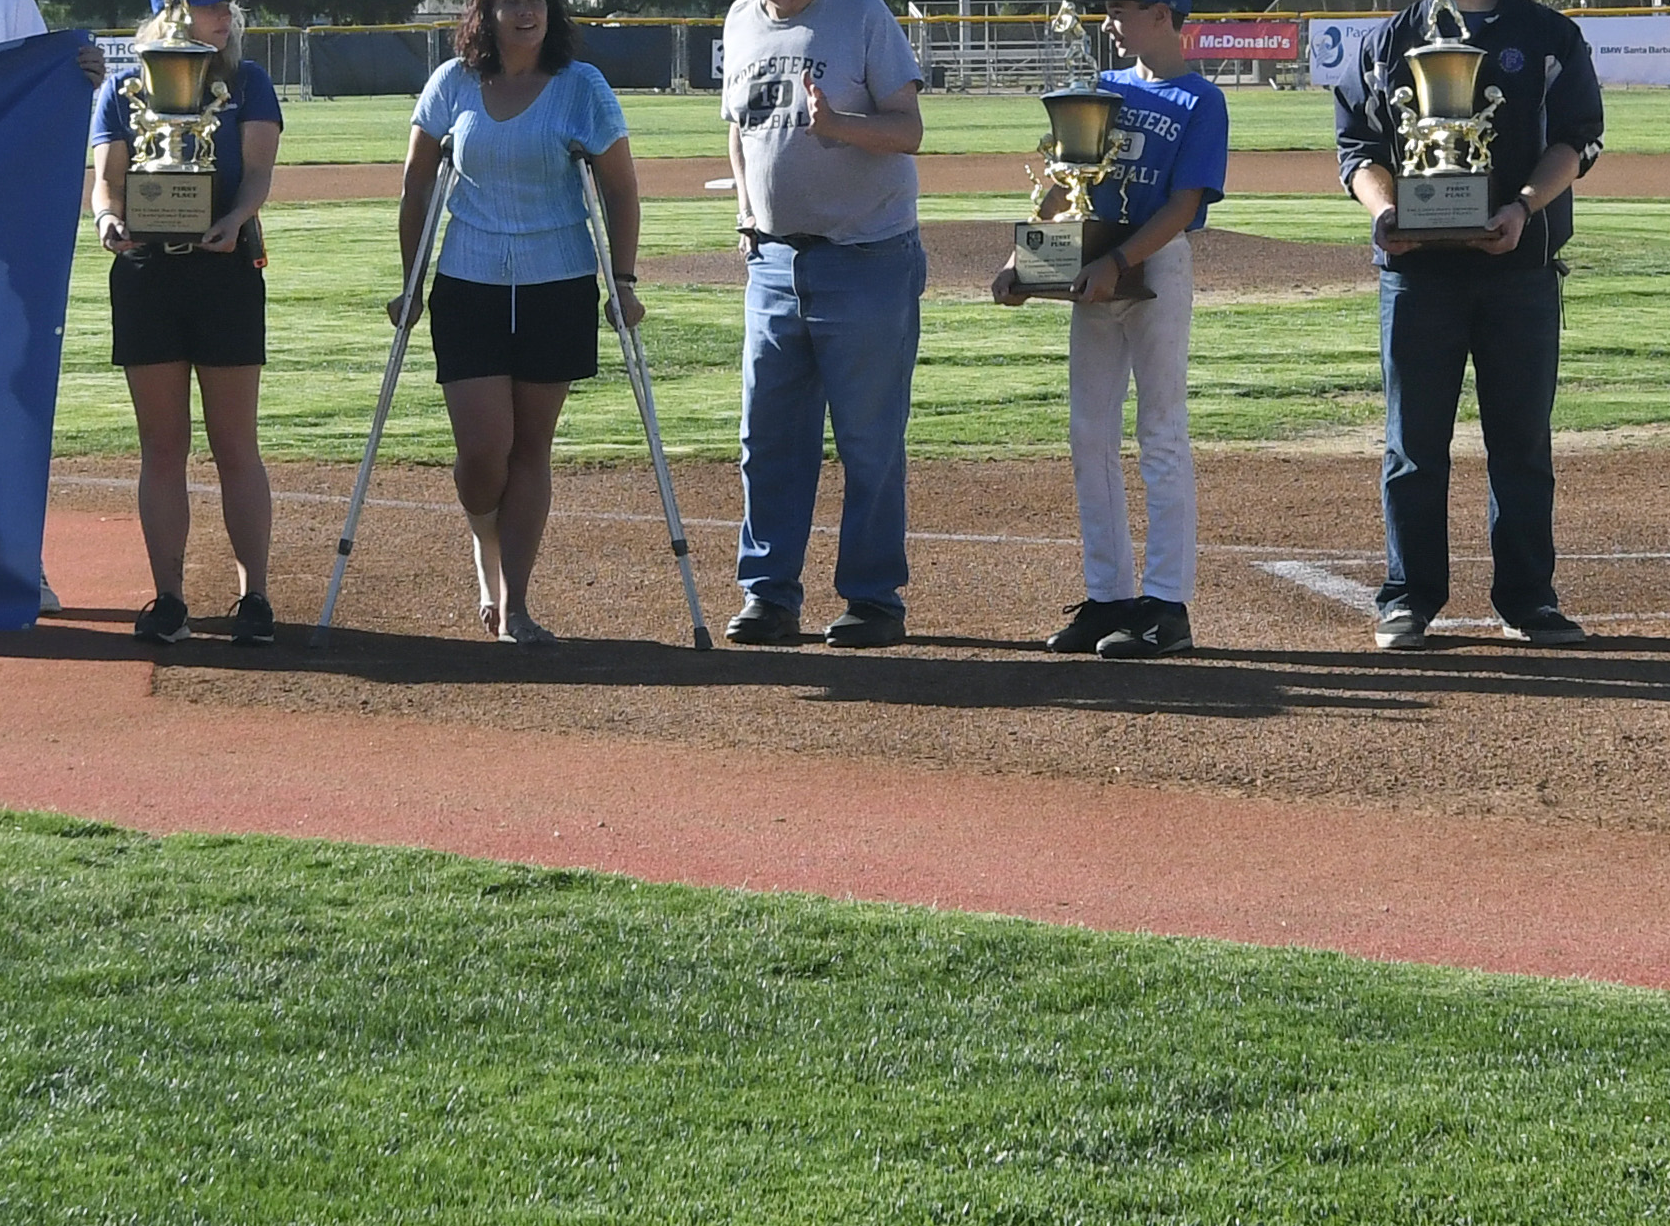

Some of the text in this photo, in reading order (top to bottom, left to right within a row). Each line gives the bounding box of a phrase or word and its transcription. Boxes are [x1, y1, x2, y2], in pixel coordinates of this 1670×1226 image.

[1199, 35, 1291, 49] McDonald's
[1600, 46, 1622, 54] BMW
[1623, 46, 1647, 54] Santa
